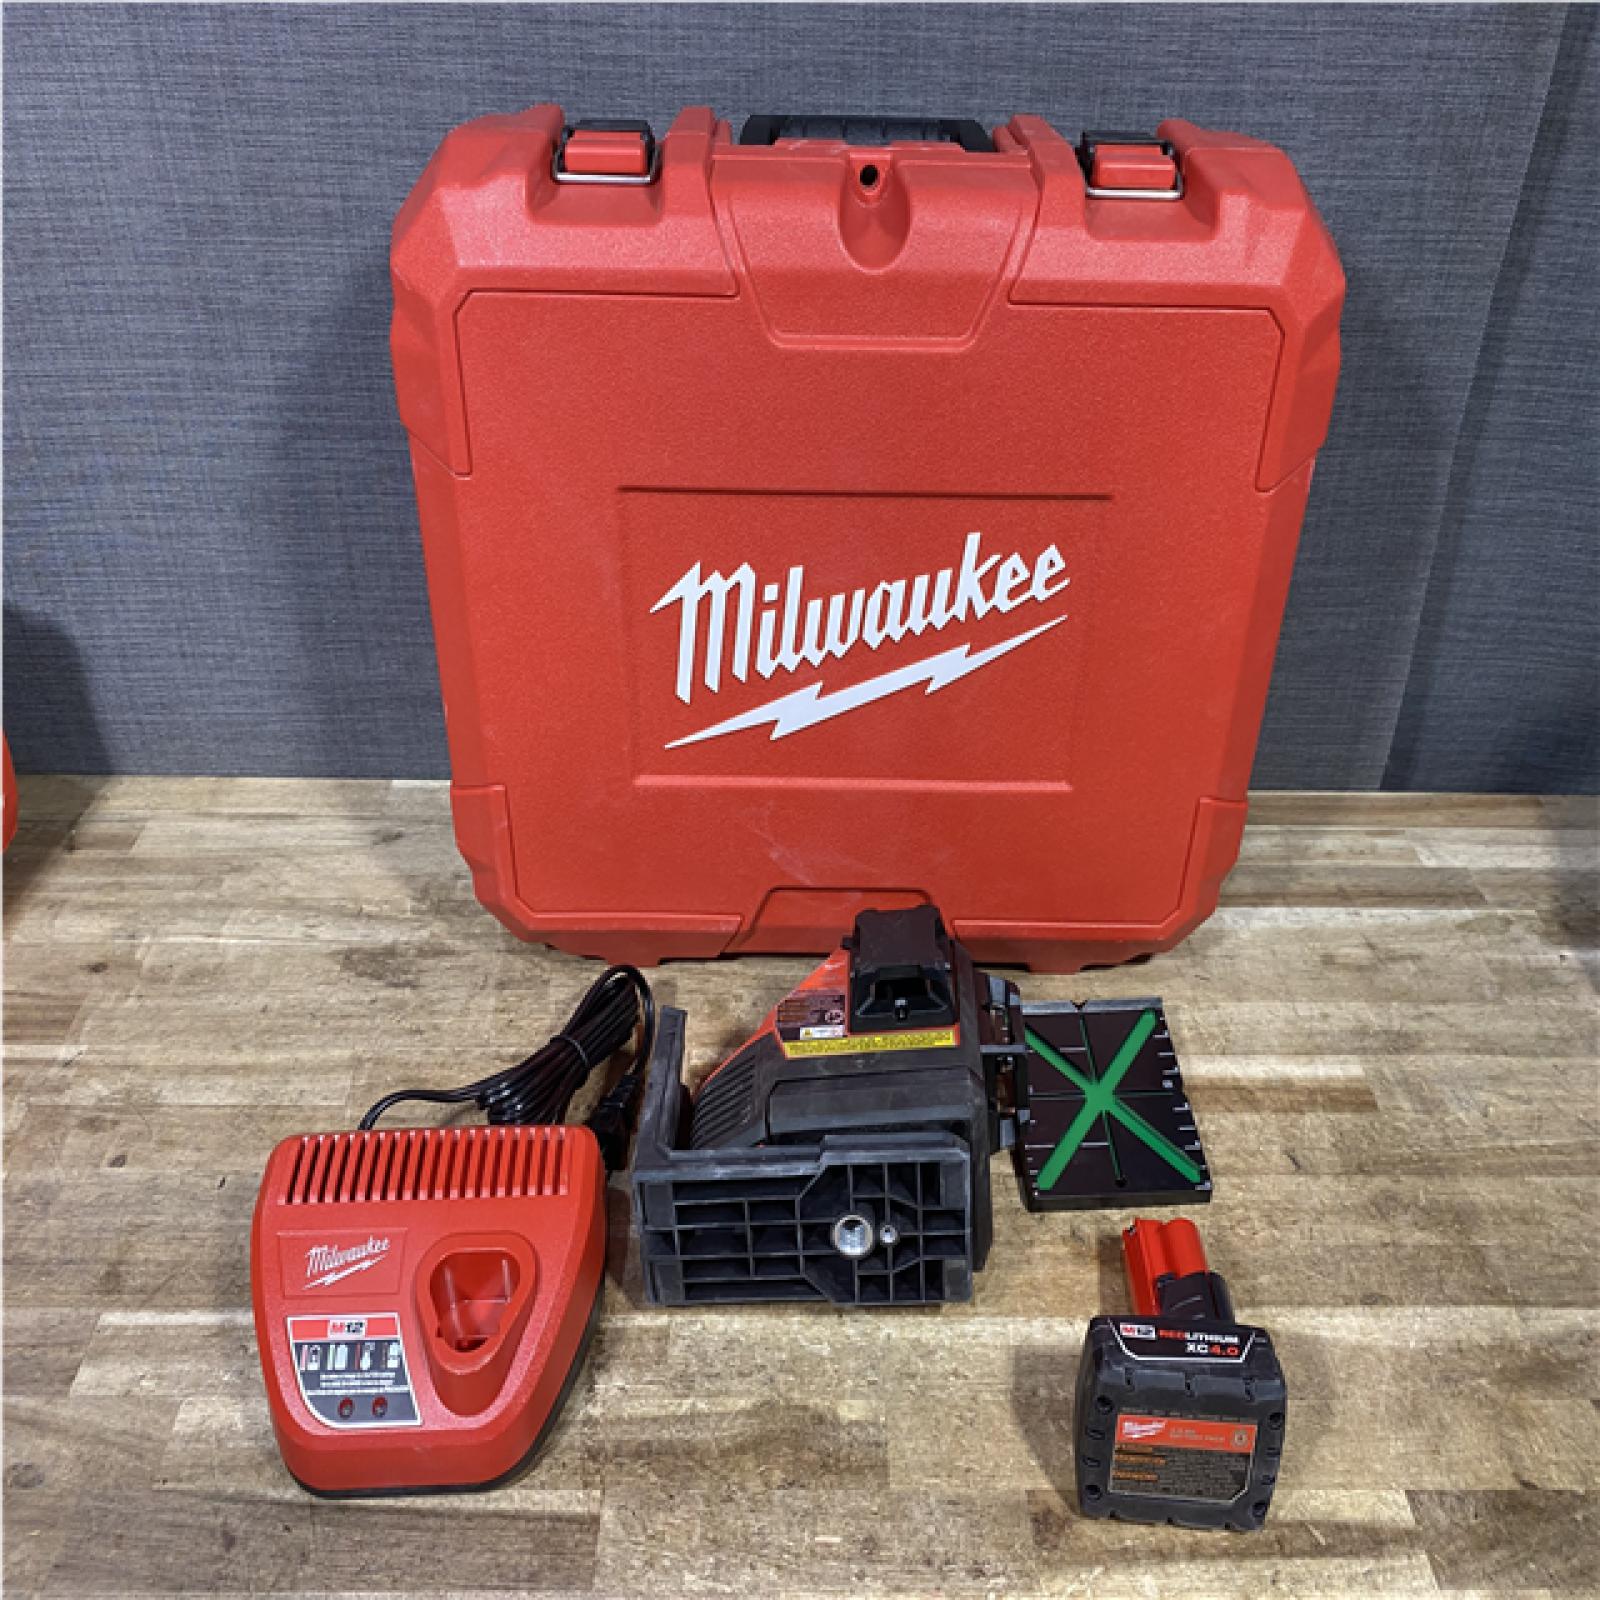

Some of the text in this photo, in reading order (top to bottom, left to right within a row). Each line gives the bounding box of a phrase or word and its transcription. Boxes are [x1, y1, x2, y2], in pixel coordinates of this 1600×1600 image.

[650, 532, 1070, 705] Milwaukee
[305, 1235, 390, 1277] Milwaukee
[331, 1321, 364, 1334] M12
[1121, 1325, 1154, 1336] M12
